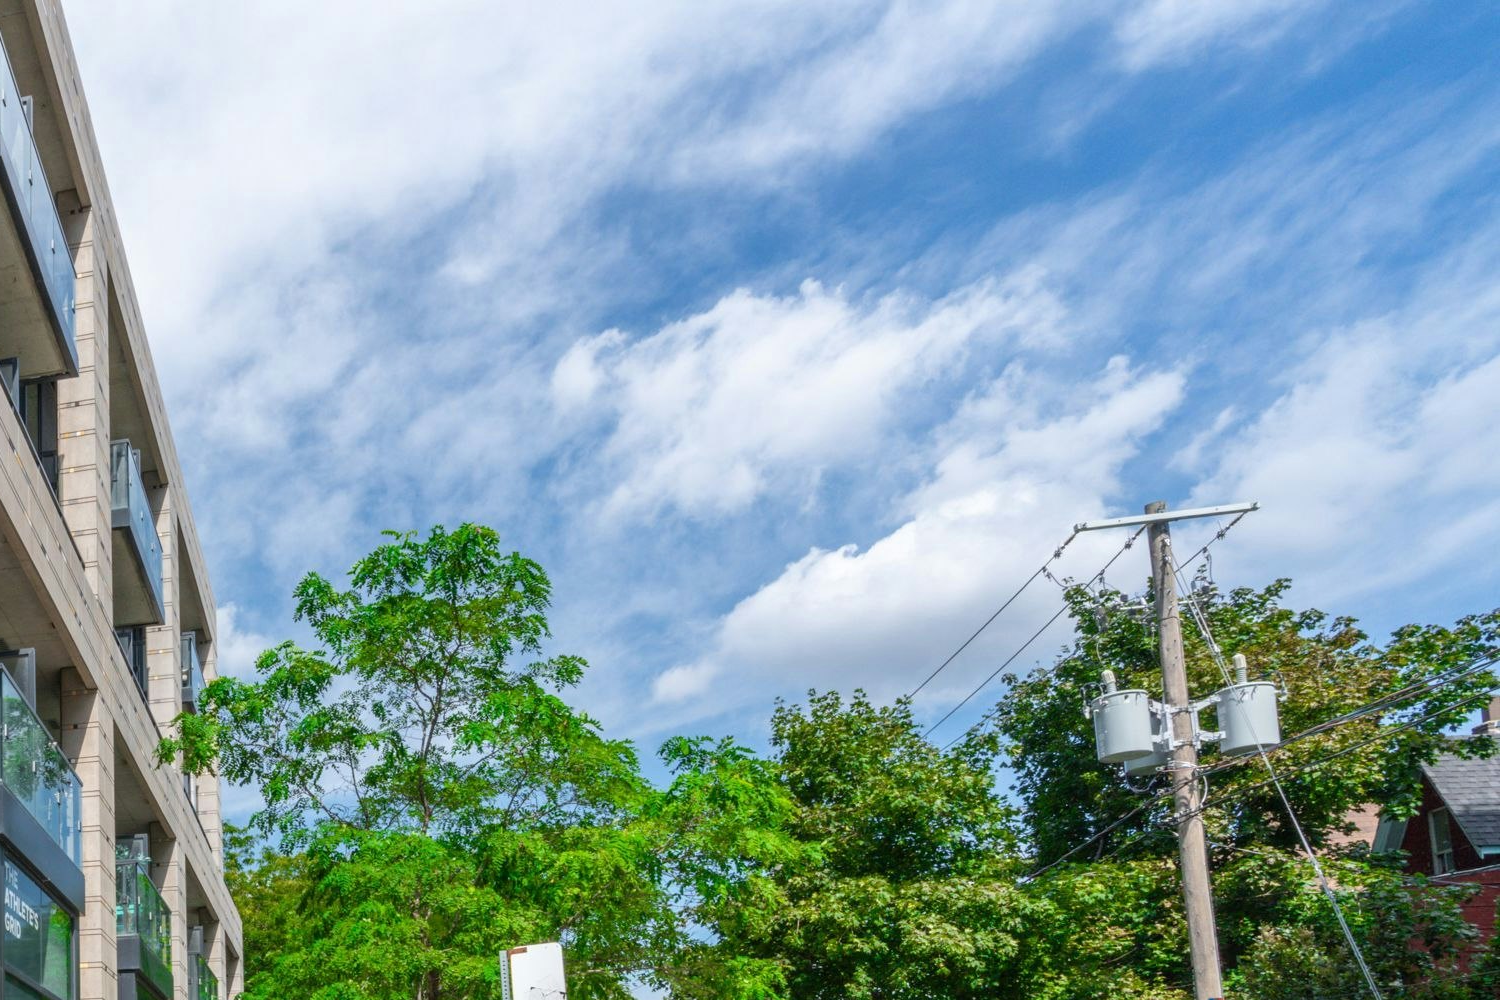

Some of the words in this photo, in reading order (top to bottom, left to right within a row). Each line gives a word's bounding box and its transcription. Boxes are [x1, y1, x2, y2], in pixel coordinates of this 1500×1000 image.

[4, 860, 19, 890] THE
[4, 887, 39, 931] ATHLETE'S
[4, 911, 22, 939] GRID
